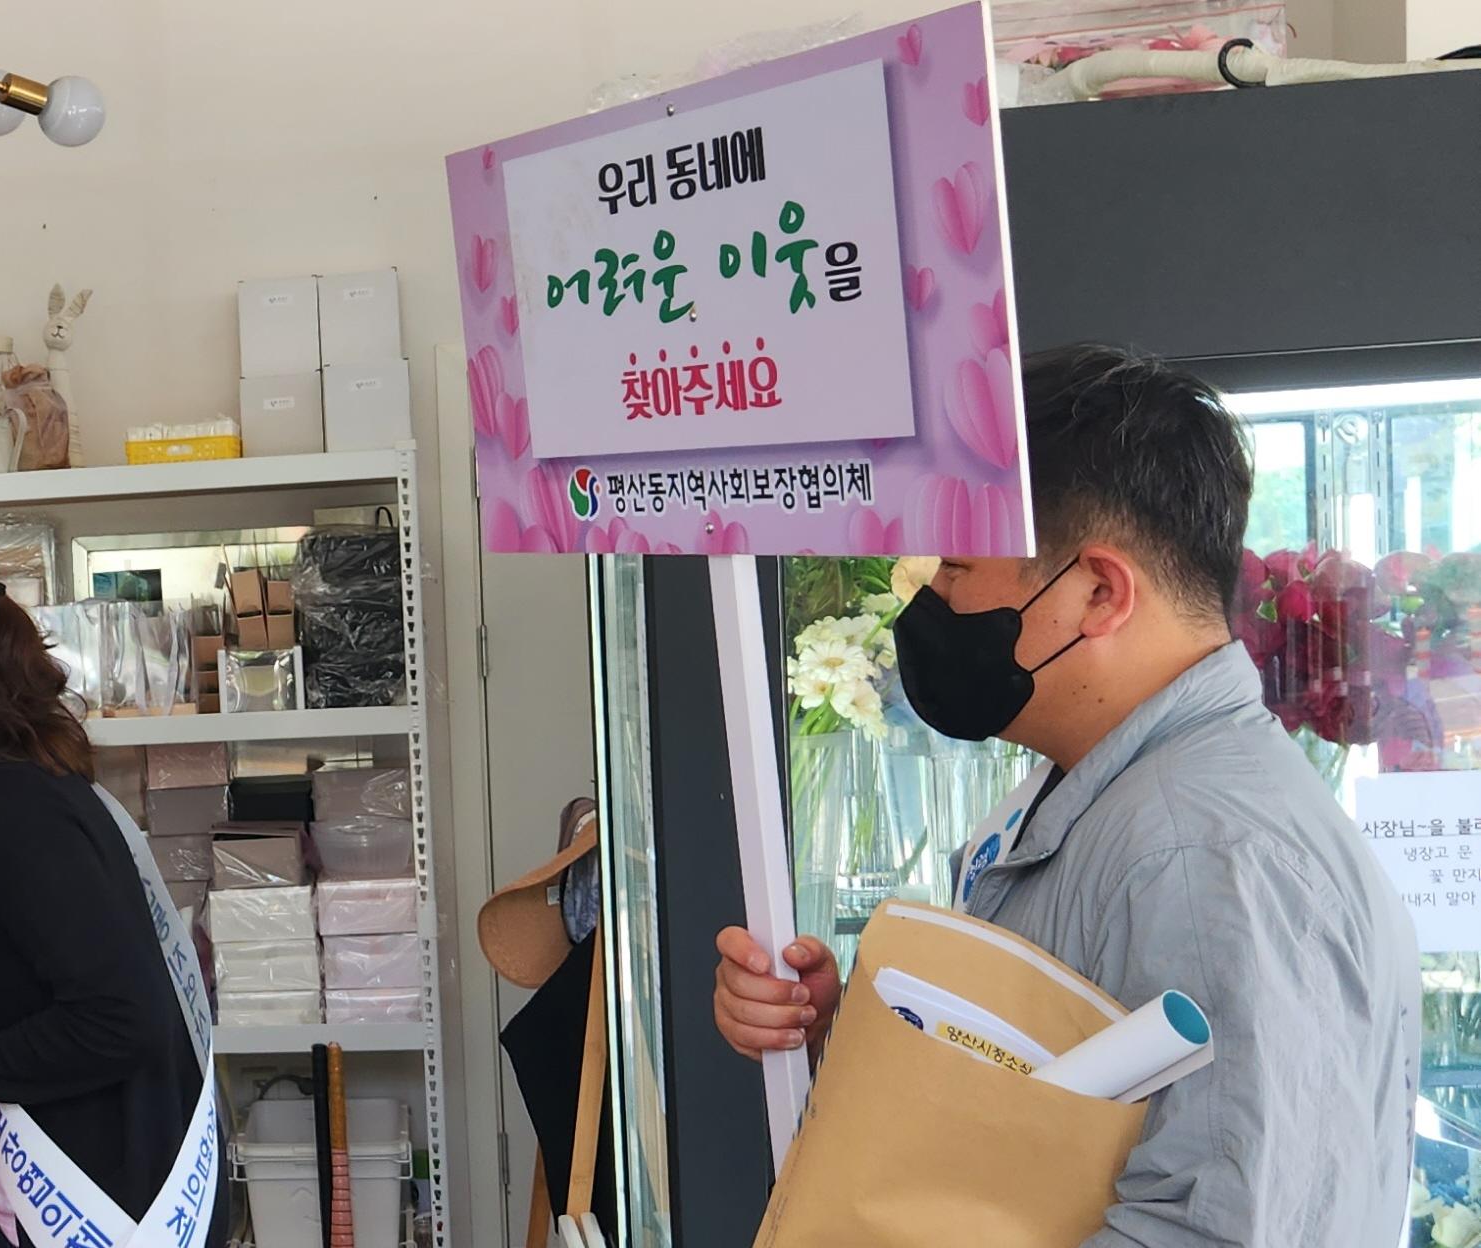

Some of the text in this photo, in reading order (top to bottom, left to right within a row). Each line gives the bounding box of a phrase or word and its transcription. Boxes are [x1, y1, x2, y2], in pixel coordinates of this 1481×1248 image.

[598, 126, 766, 215] 우리 동네에
[547, 229, 695, 324] 어려운
[621, 354, 782, 420] 찾아주세요
[607, 463, 872, 514] 평산동지역사회보장협의체
[1361, 818, 1445, 839] 사장님~을
[1404, 845, 1472, 862] 냉장고 문
[1402, 890, 1476, 907] 내지 말아
